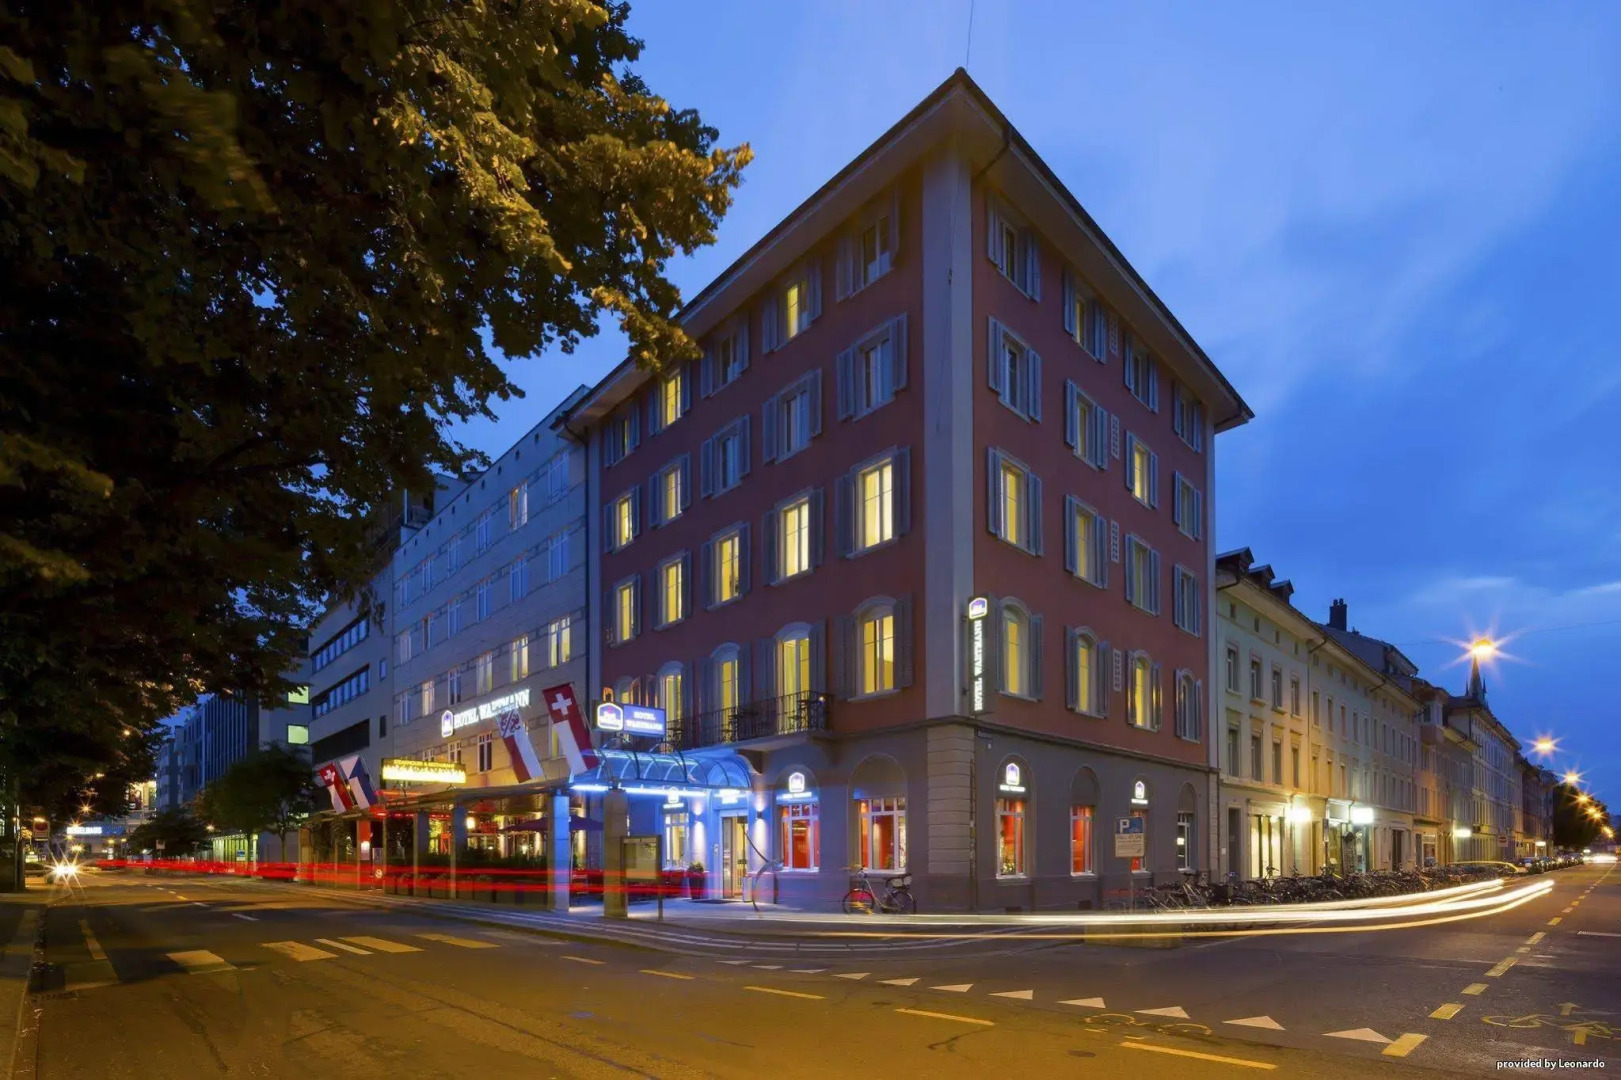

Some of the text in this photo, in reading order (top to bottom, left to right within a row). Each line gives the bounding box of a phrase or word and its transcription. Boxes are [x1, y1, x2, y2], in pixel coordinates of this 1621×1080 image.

[974, 678, 983, 711] HOTEL
[454, 707, 479, 729] HOTEL
[634, 711, 656, 720] HOTEL
[1120, 819, 1130, 834] P
